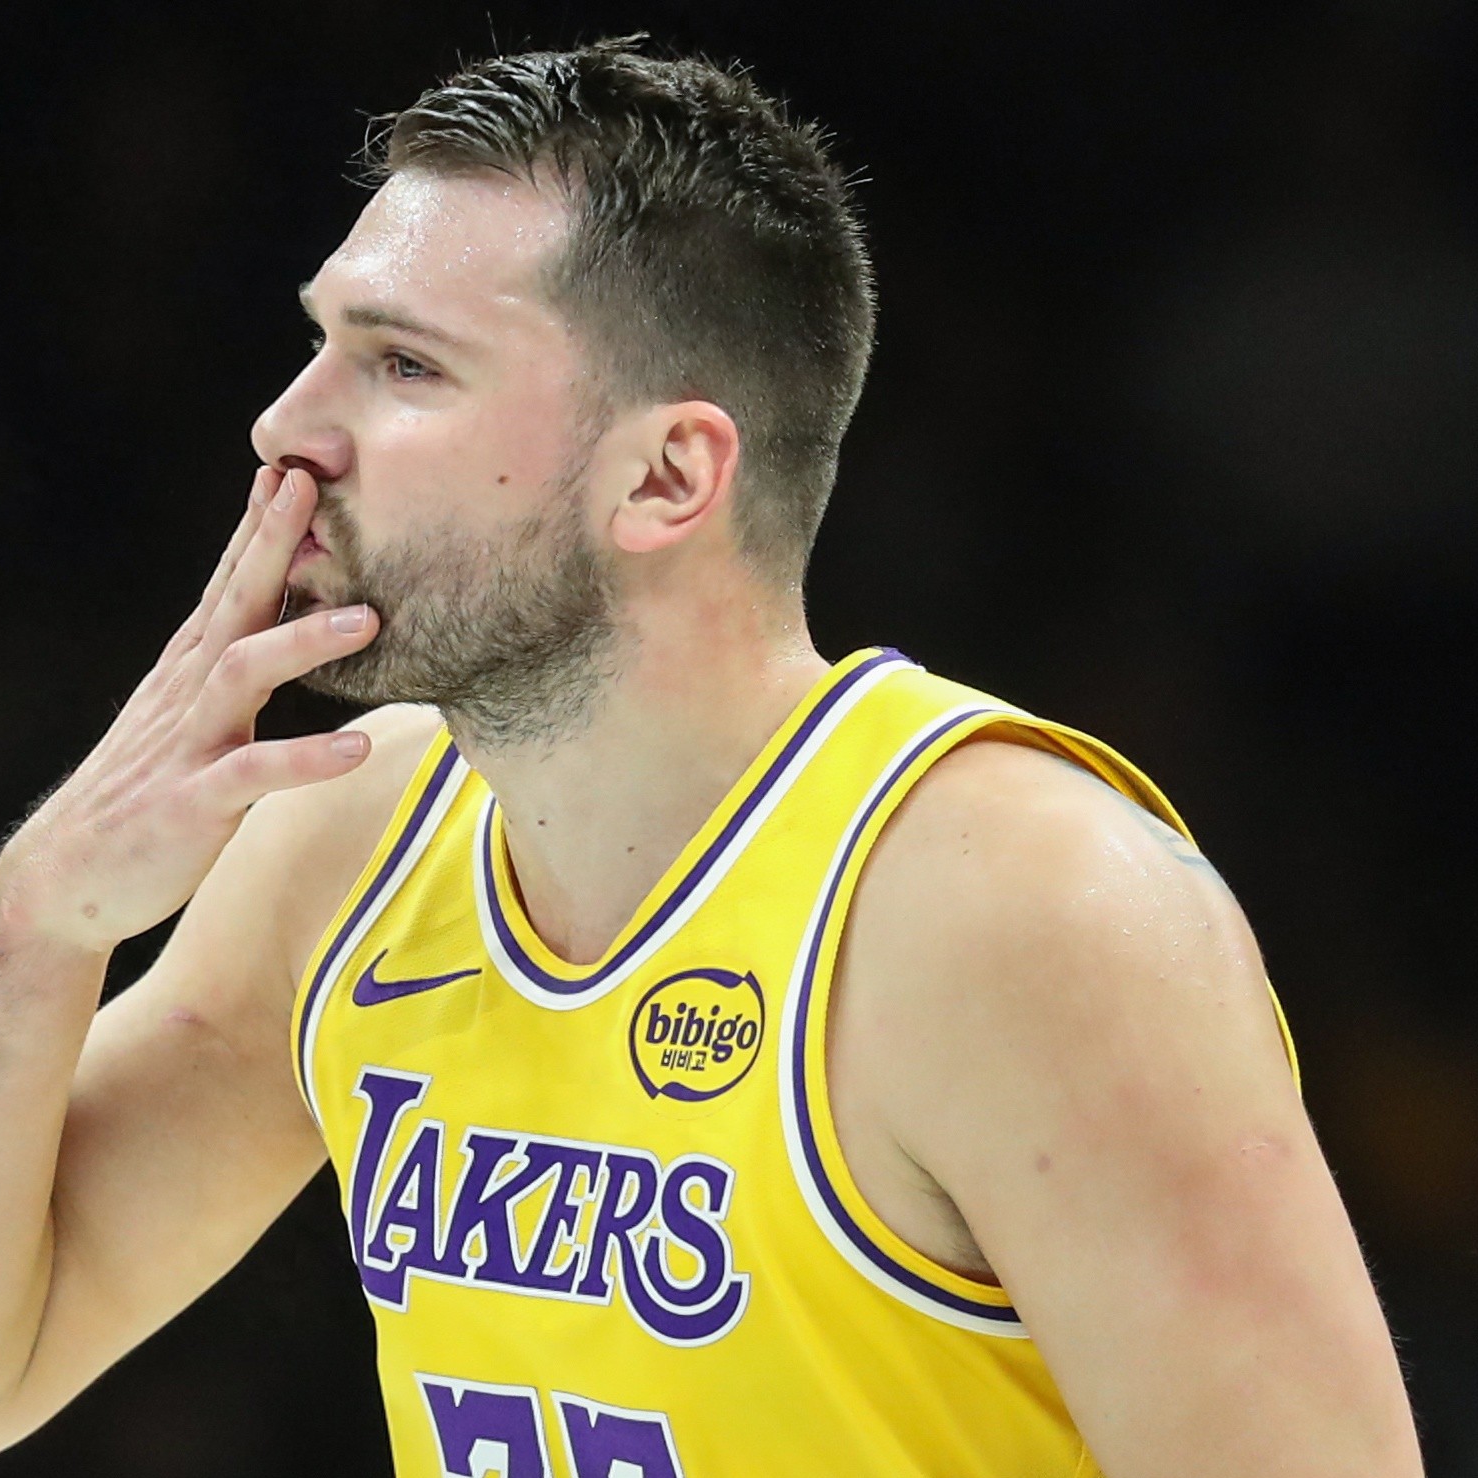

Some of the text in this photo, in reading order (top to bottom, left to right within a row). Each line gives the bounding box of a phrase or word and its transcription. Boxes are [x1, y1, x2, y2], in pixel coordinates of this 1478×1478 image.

[645, 1002, 758, 1063] bibigo
[660, 1049, 708, 1072] 비비고
[353, 1065, 751, 1347] LAKERS
